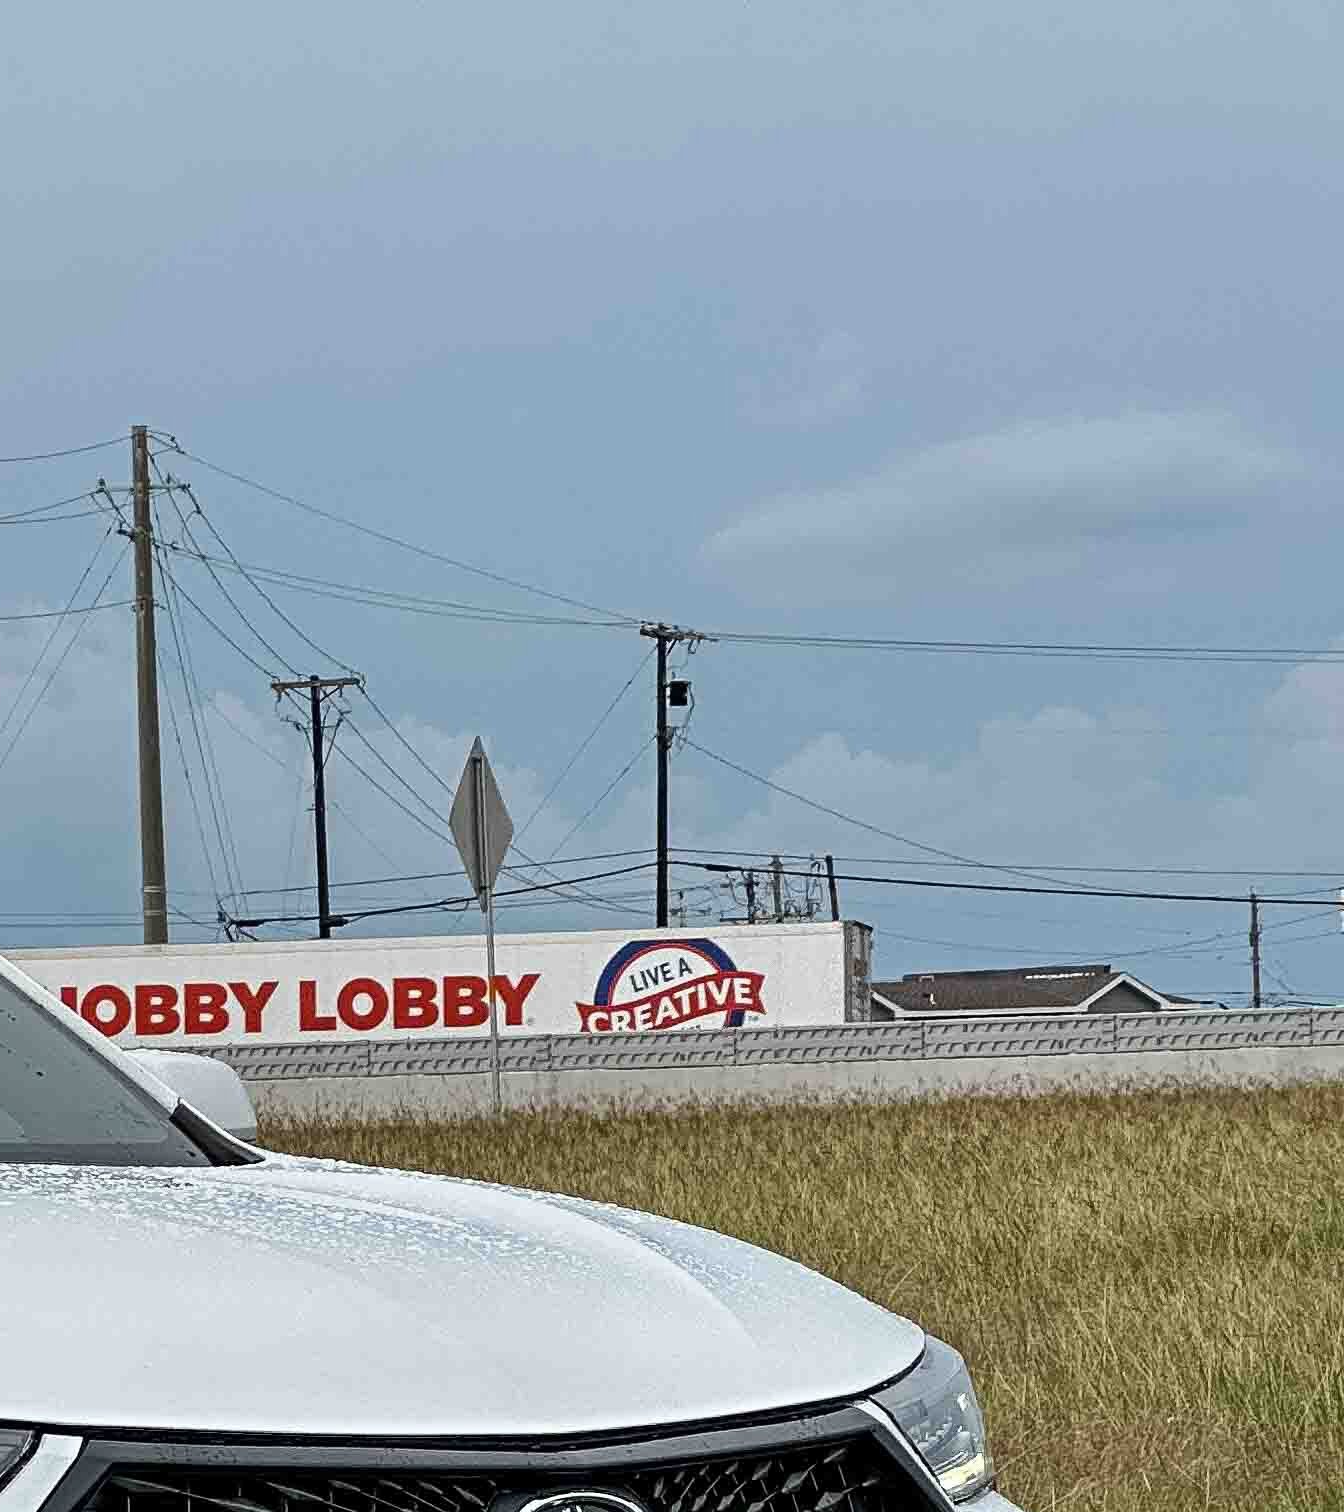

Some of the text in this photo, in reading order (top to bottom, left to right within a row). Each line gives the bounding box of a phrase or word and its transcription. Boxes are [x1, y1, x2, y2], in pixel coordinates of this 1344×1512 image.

[299, 973, 542, 1032] LOBBY
[630, 957, 693, 993] LIVE A
[587, 977, 753, 1032] CREATIVE
